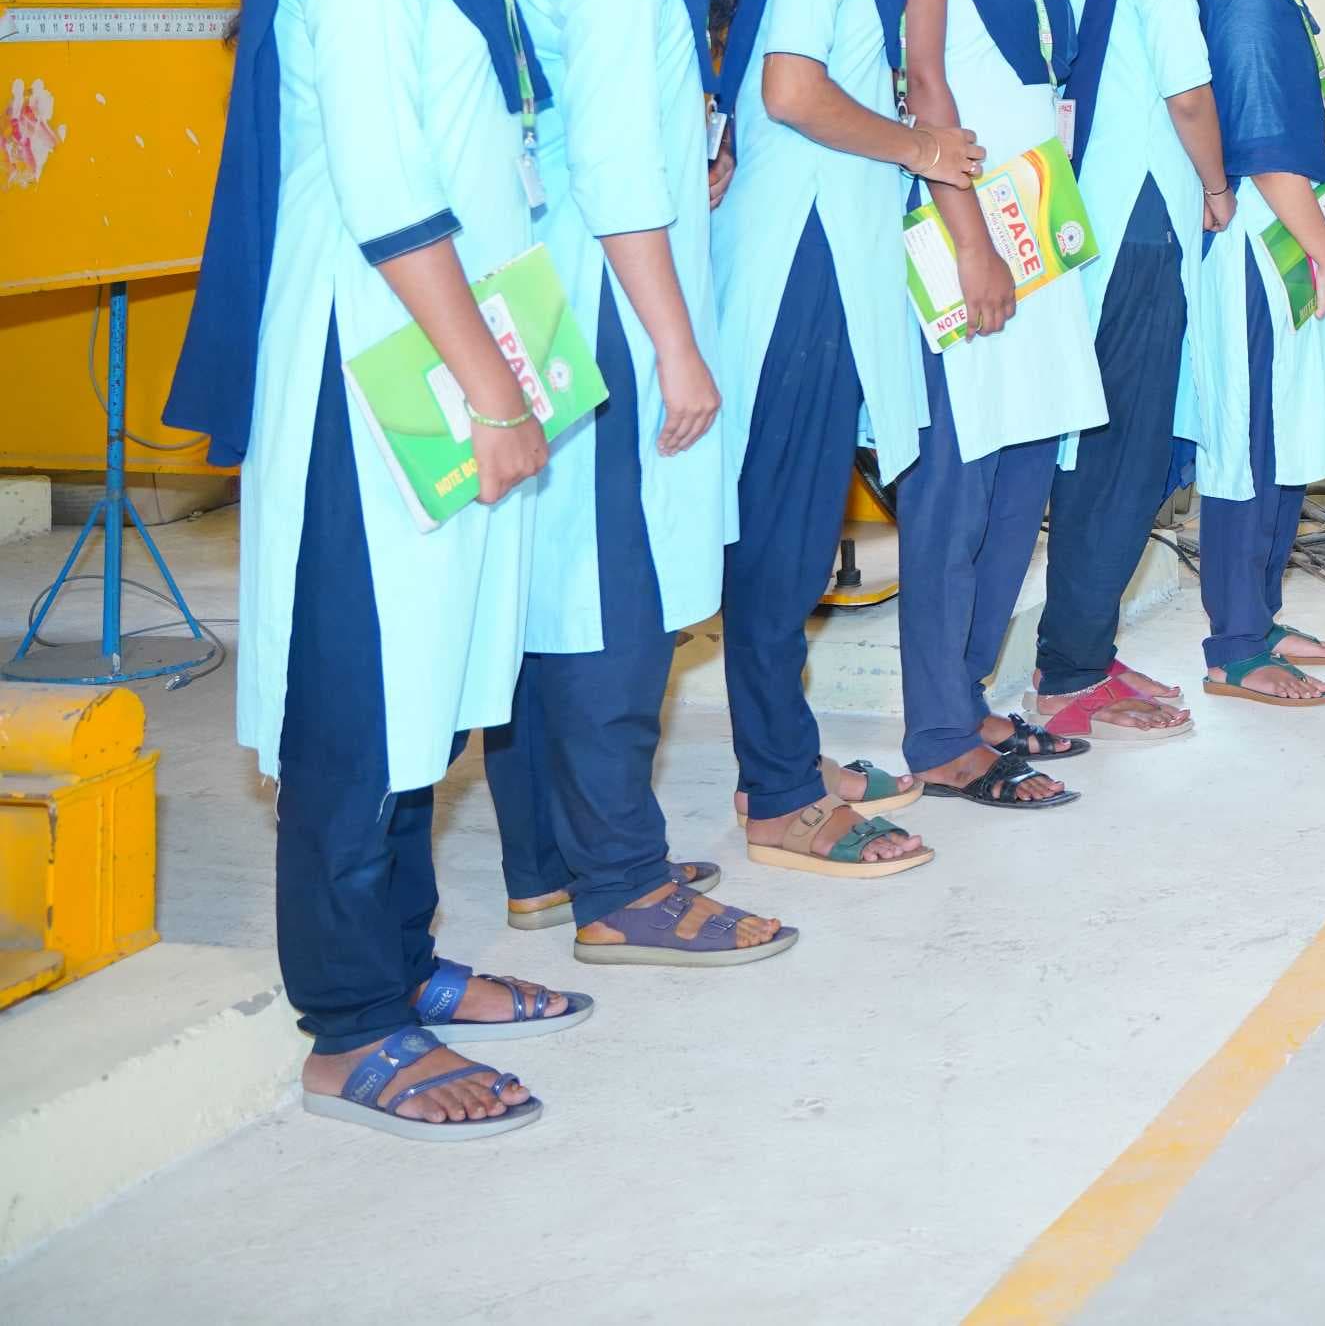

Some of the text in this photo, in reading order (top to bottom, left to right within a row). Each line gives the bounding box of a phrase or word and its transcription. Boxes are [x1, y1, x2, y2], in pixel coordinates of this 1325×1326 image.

[1002, 202, 1040, 275] PACE
[937, 309, 966, 331] NOTE
[499, 331, 546, 416] PACE
